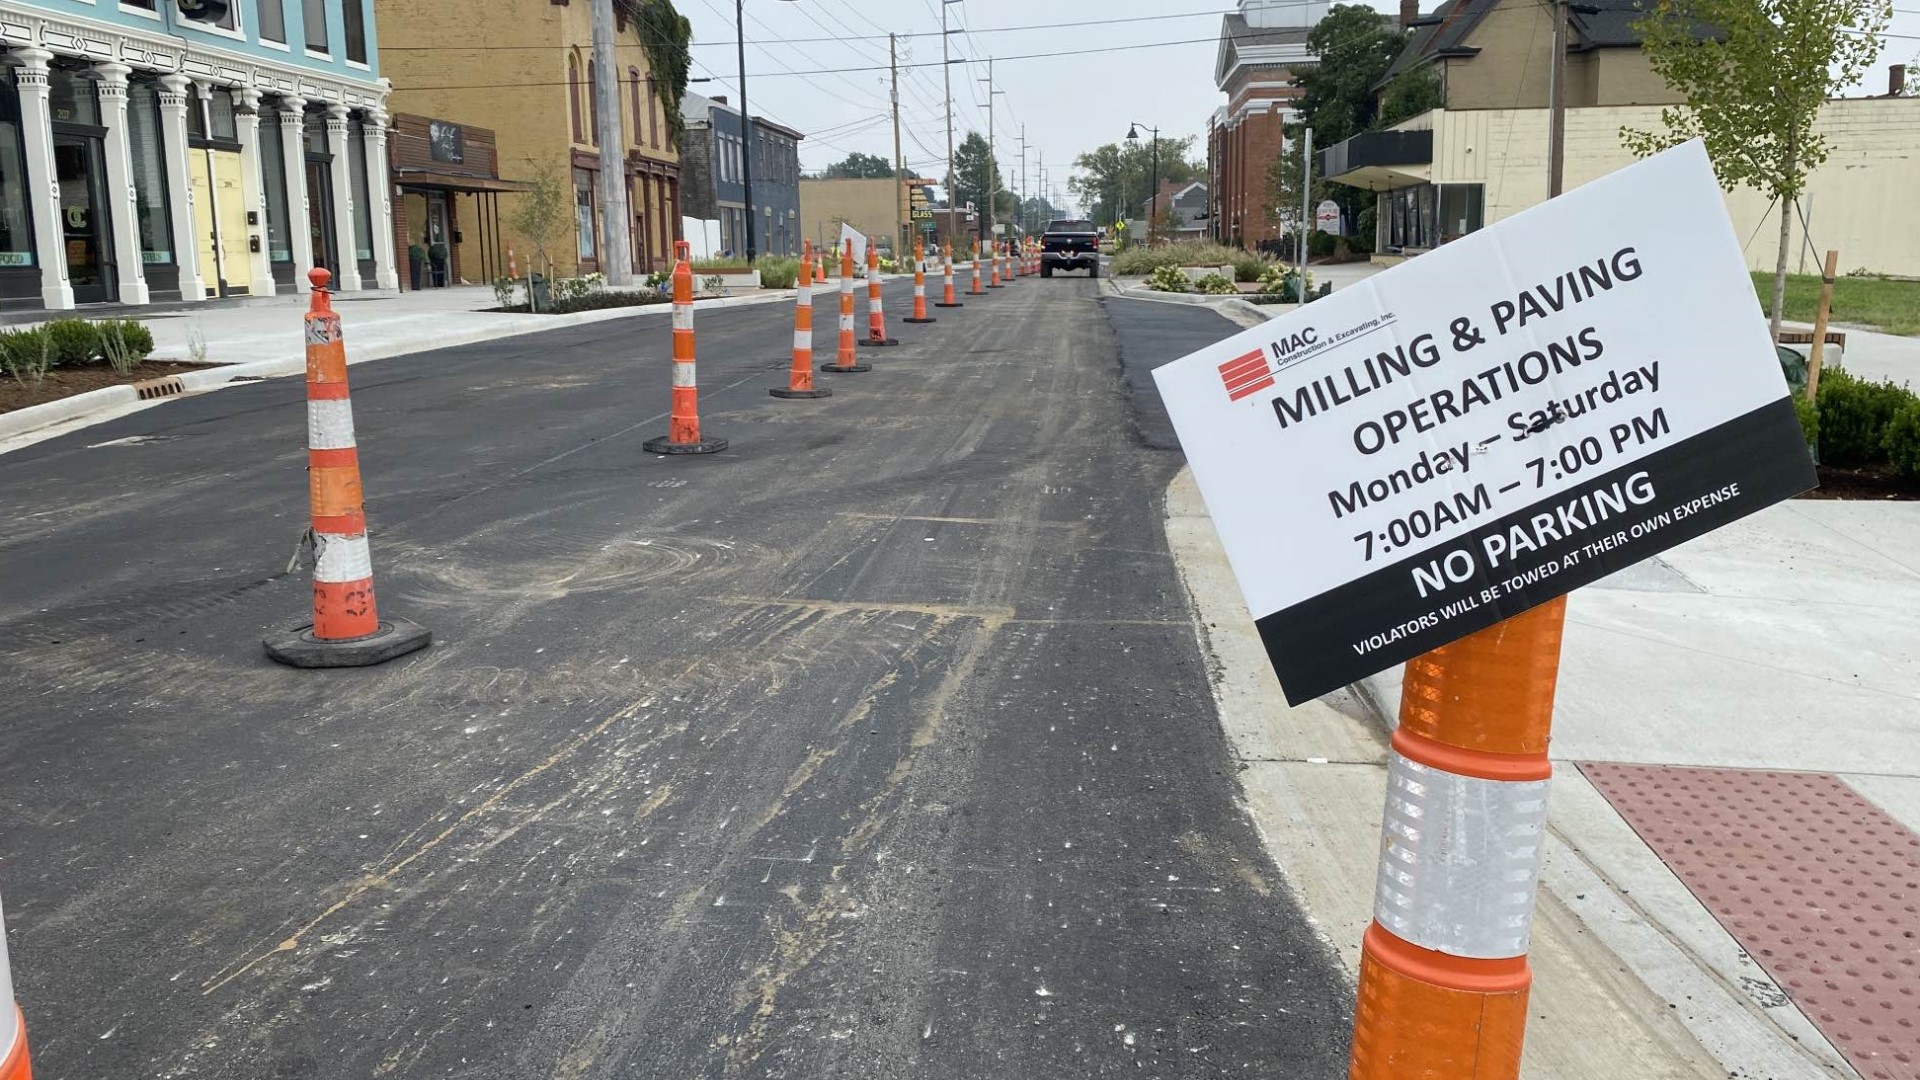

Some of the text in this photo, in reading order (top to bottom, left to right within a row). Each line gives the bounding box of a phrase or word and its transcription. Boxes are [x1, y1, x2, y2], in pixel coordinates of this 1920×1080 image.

[57, 108, 70, 119] 207
[912, 210, 932, 218] GLASS
[1271, 247, 1643, 429] MILLING & PAVING
[1271, 327, 1318, 358] MAC
[1277, 312, 1396, 366] Construction & Excavating, Inc.
[1353, 326, 1604, 455] OPERATIONS
[1328, 442, 1470, 518] Monday
[1507, 360, 1659, 442] Saturday
[1353, 483, 1492, 561] 7:00AM
[1525, 436, 1603, 489] 7:00
[1609, 407, 1670, 454] PM
[1352, 482, 1741, 656] VIOLATORS WILL BE TOWED AT THEIR OWN EXPENSE
[1411, 471, 1656, 598] NO PARKING
